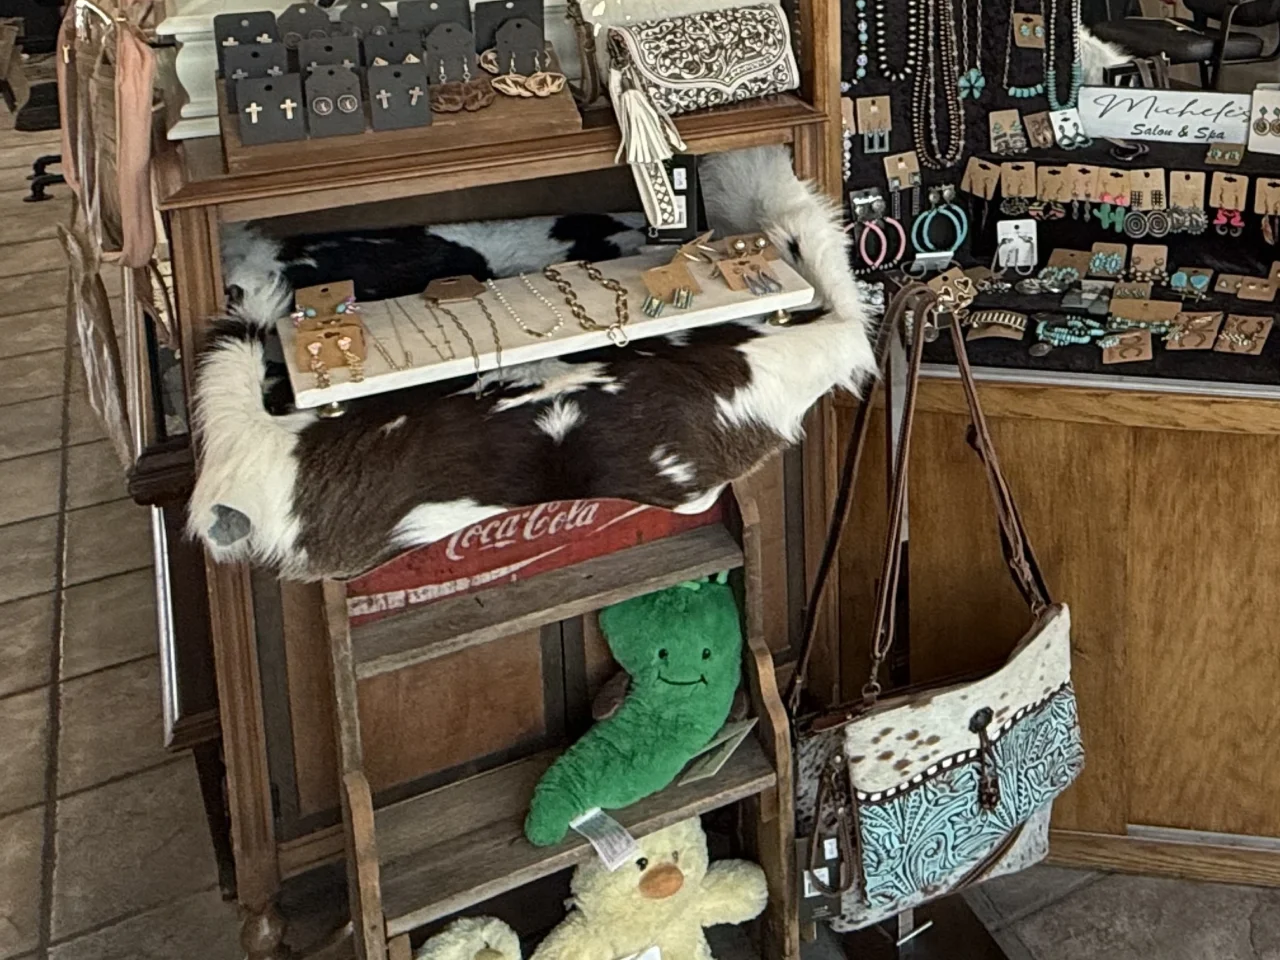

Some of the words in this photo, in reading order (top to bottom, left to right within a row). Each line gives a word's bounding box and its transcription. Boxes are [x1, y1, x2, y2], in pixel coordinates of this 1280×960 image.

[1131, 123, 1173, 136] Salon
[1178, 125, 1189, 138] &
[1194, 127, 1226, 140] Spa
[446, 501, 601, 561] Coca-Cola
